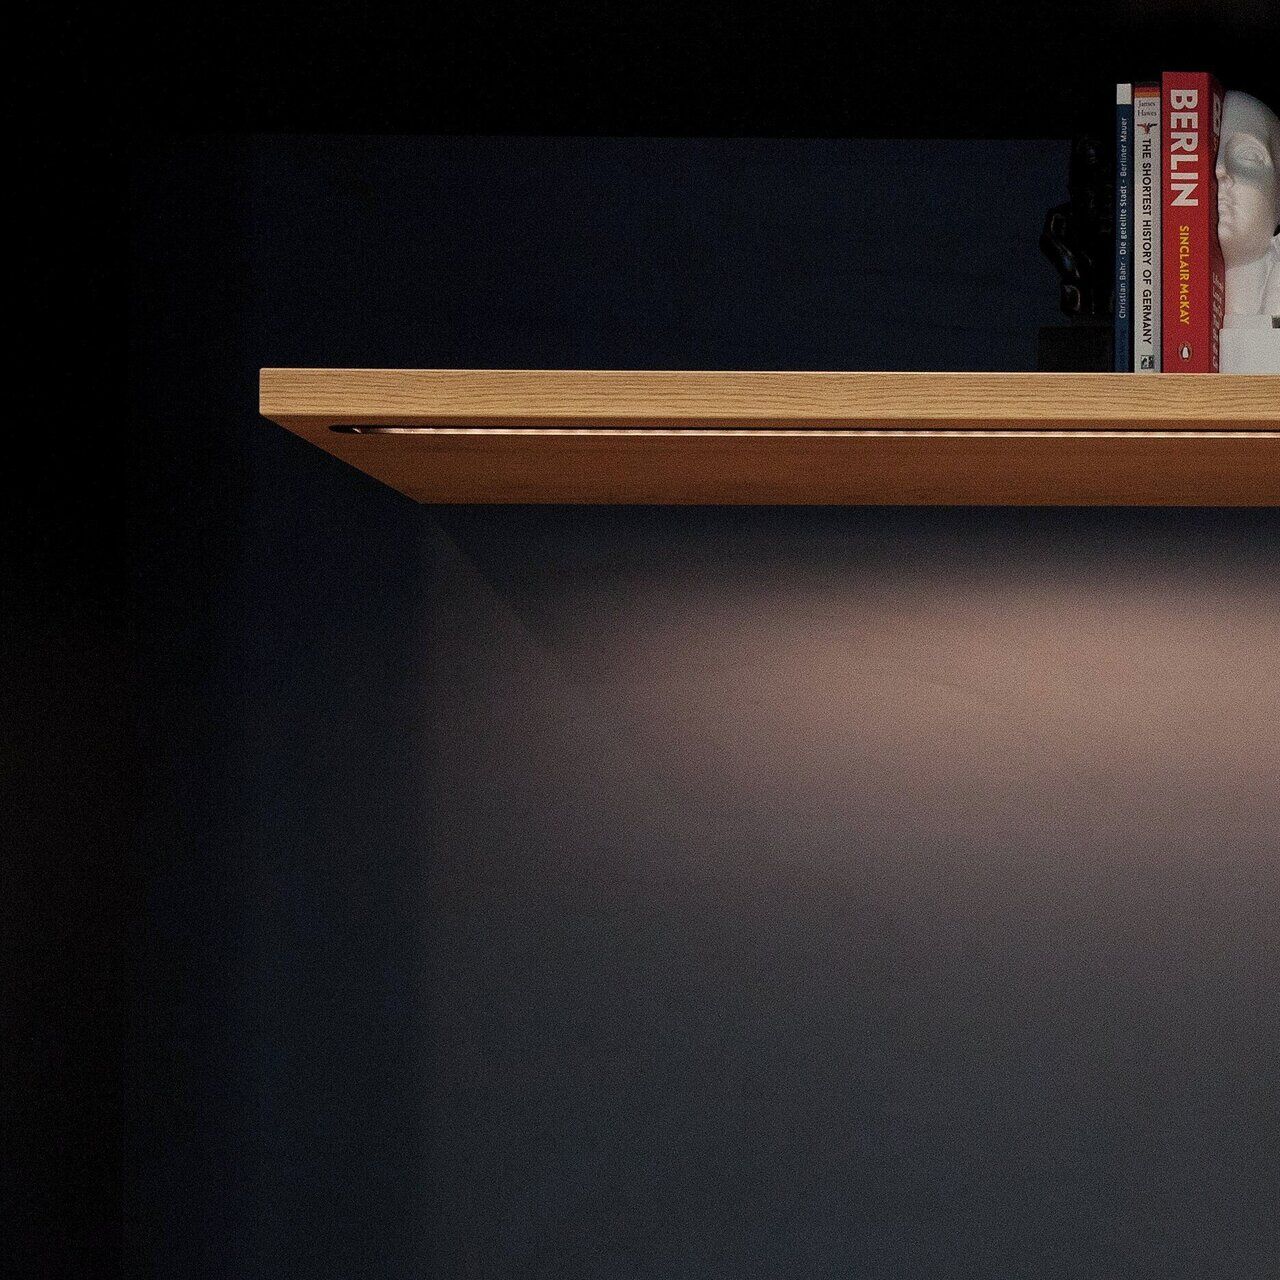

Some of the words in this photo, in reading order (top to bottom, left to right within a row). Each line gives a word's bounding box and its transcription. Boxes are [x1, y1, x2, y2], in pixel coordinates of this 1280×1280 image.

[1120, 118, 1128, 141] Mauer
[1142, 139, 1152, 159] THE
[1170, 90, 1198, 206] BERLIN
[1142, 163, 1152, 216] SHORTEST
[1120, 208, 1128, 240] geteilte
[1142, 220, 1152, 266] HISTORY
[1179, 225, 1190, 280] SINCLAIR
[1142, 271, 1152, 285] OF
[1118, 284, 1126, 318] Christian
[1142, 289, 1152, 345] GERMANY
[1179, 283, 1190, 325] McKAY
